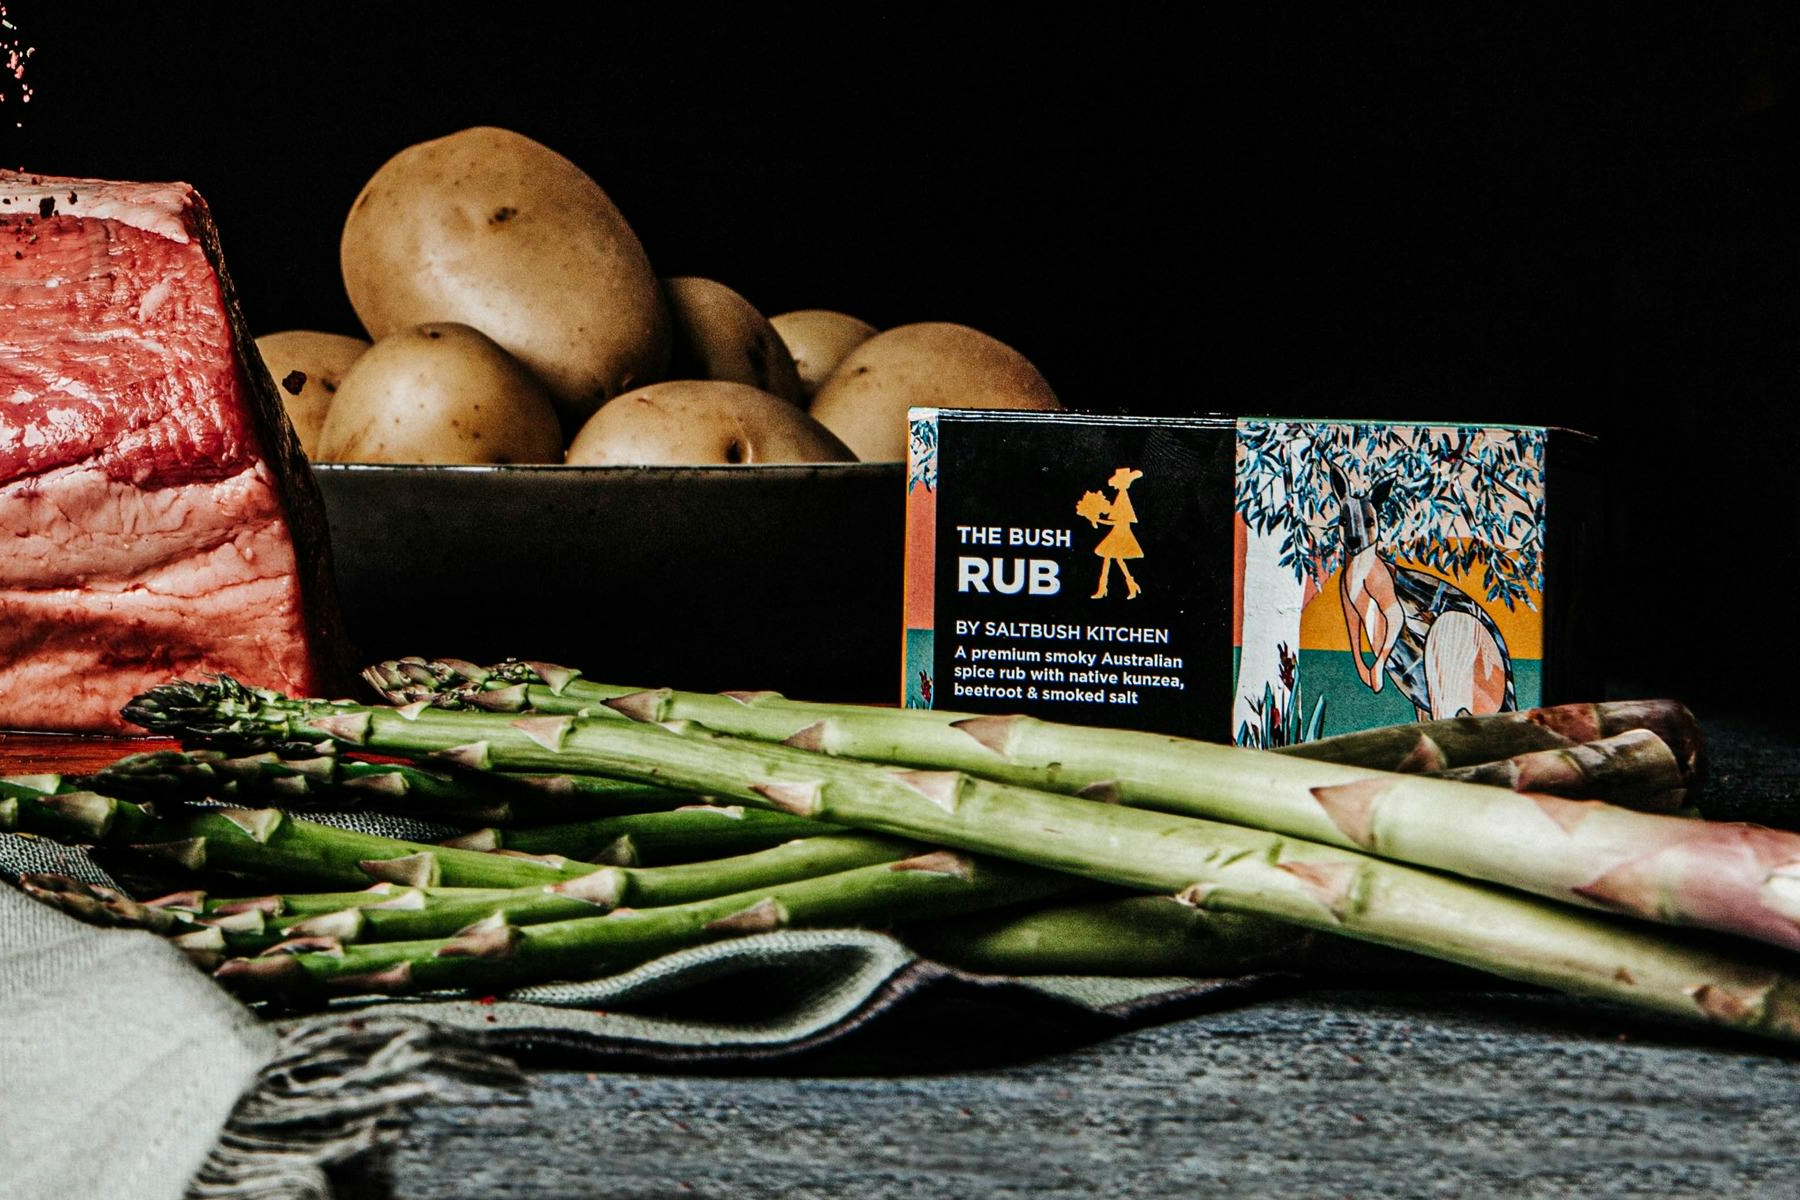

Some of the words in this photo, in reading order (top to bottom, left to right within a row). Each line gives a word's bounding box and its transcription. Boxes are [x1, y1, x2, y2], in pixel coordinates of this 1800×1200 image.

[957, 526, 1002, 545] THE
[1009, 528, 1071, 547] BUSH
[958, 557, 1061, 595] RUB
[956, 620, 980, 636] BY
[985, 622, 1081, 640] SALTBUSH
[1086, 626, 1169, 643] KITCHEN
[955, 646, 966, 659] A
[971, 648, 1041, 662] premium
[1045, 651, 1096, 667] smoky
[1101, 652, 1183, 668] Australian
[954, 665, 995, 679] spice
[1000, 667, 1026, 680] rub
[1030, 668, 1064, 682] with
[1069, 670, 1118, 685] native
[1123, 672, 1185, 690] kunzea,
[954, 684, 1022, 699] beetroot
[1027, 687, 1038, 699] &
[1042, 688, 1105, 703] smoked
[1109, 691, 1138, 704] salt
